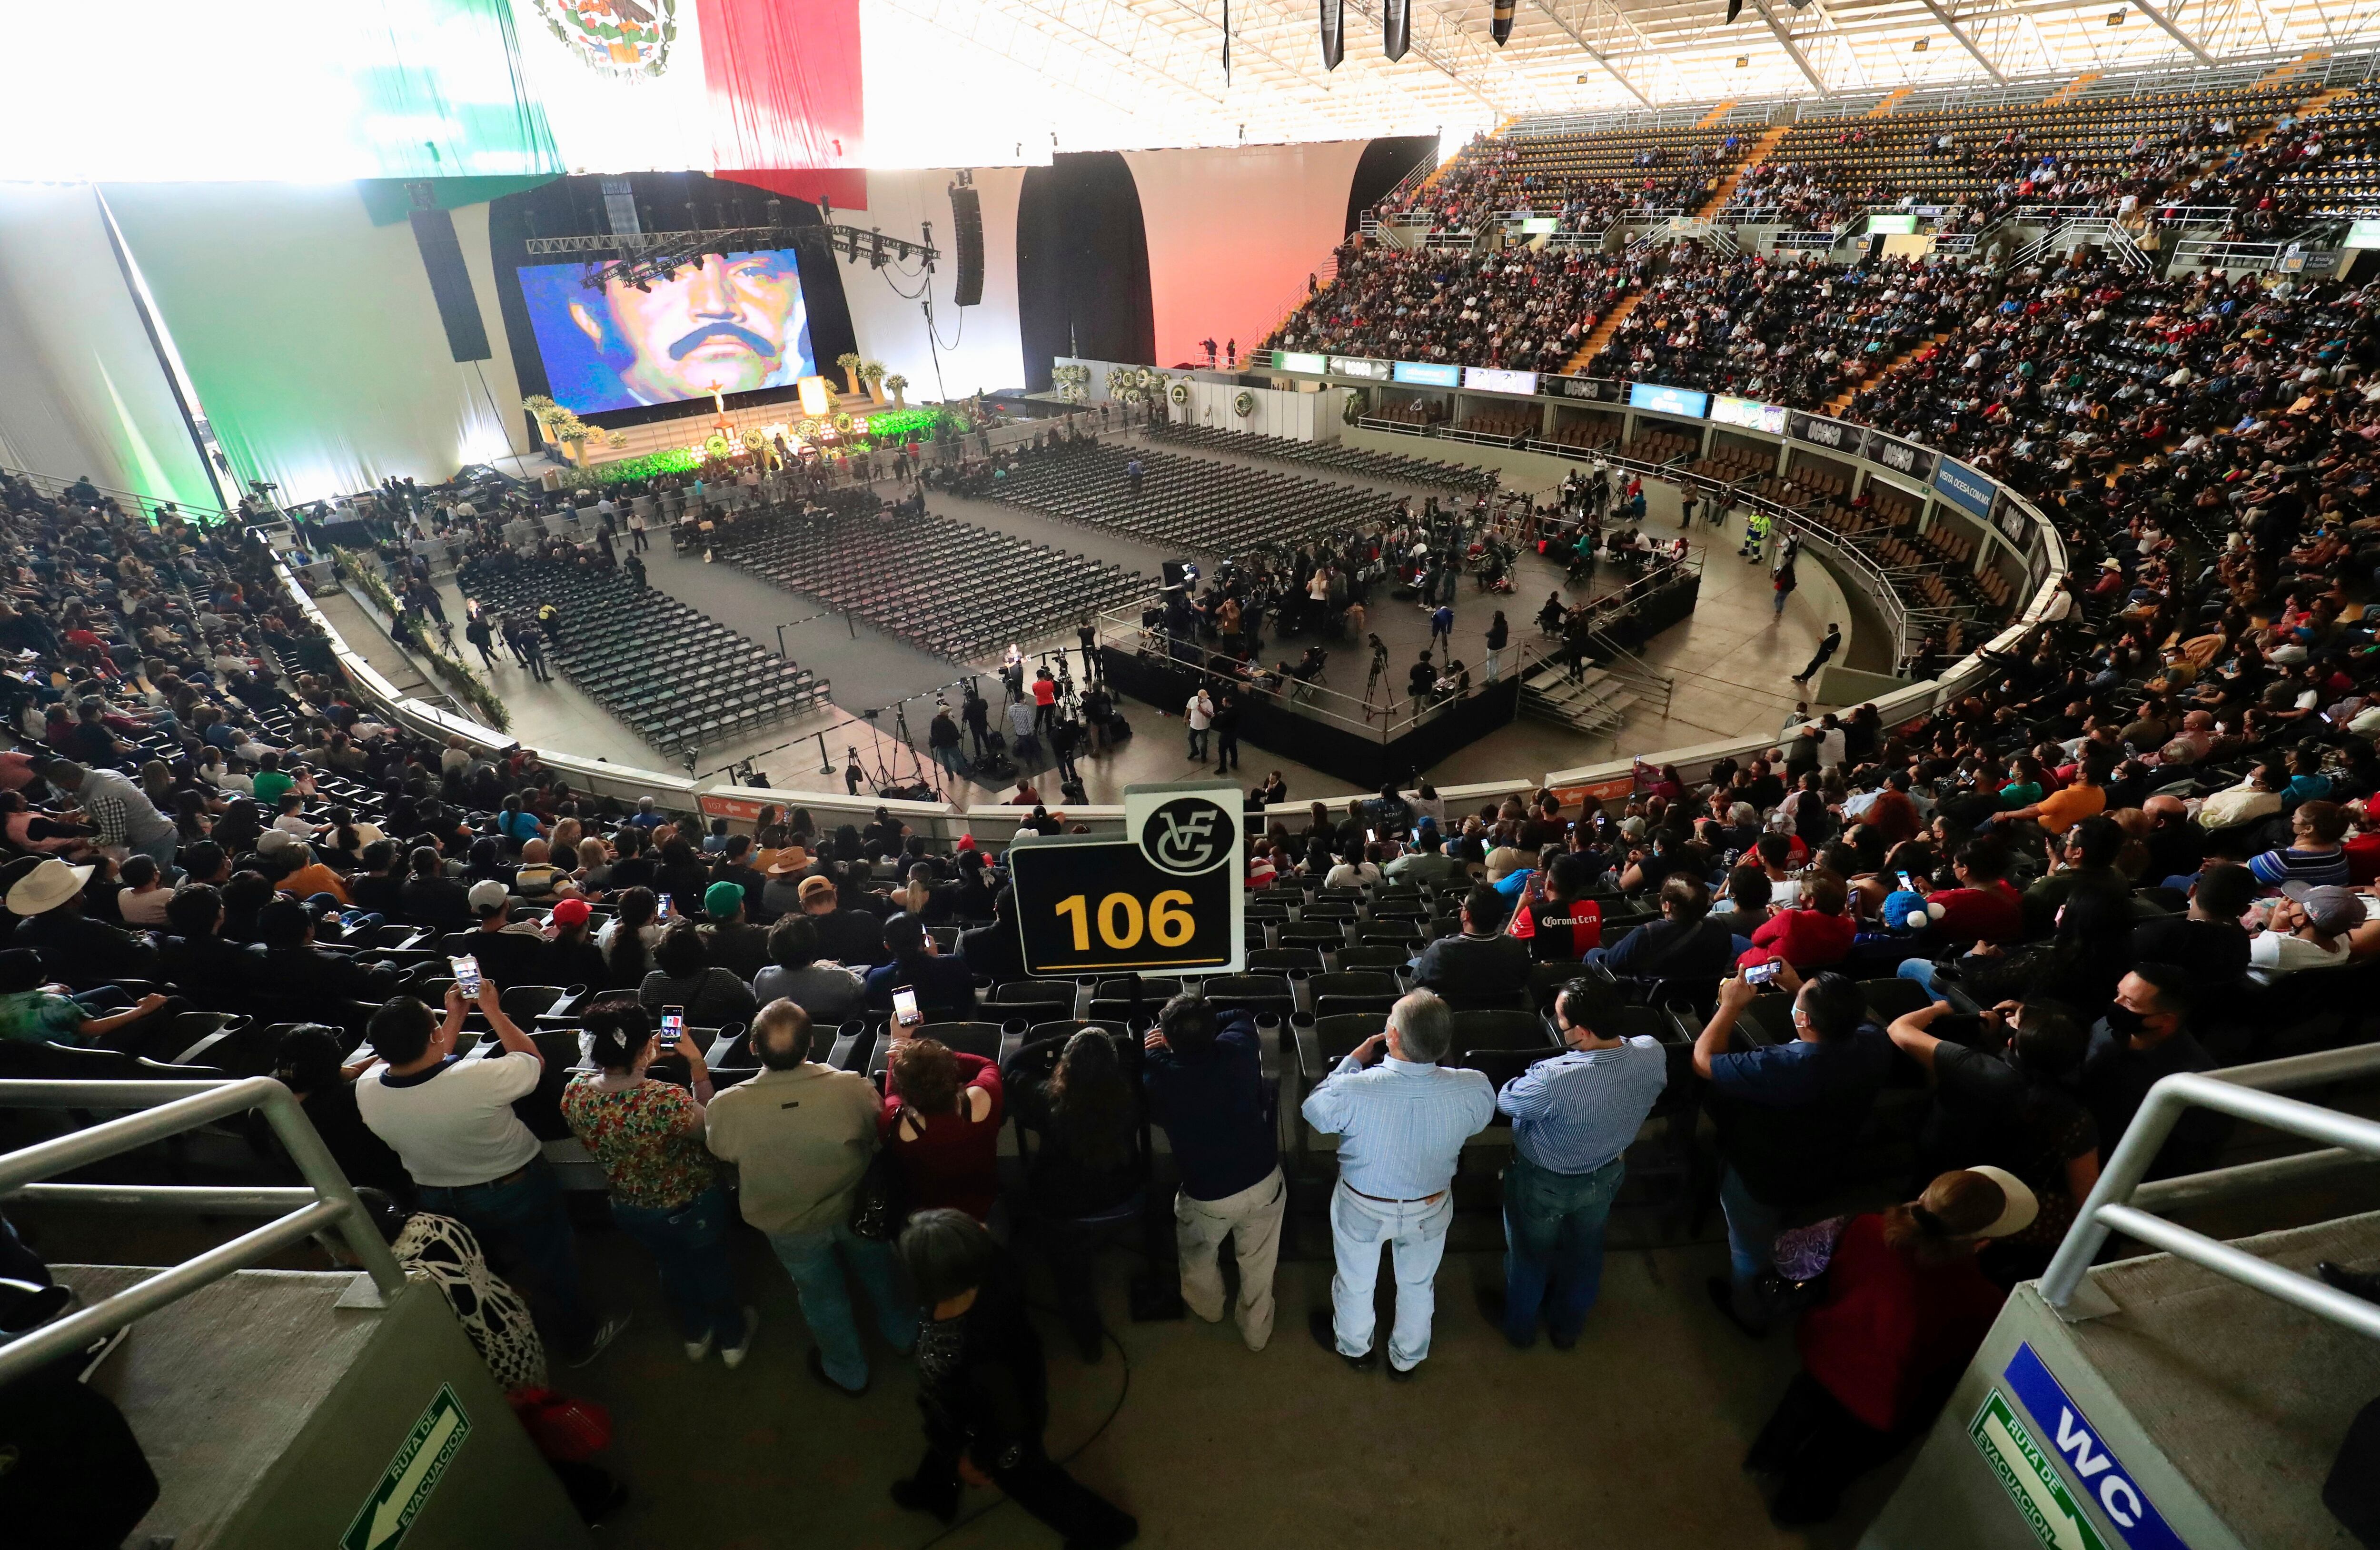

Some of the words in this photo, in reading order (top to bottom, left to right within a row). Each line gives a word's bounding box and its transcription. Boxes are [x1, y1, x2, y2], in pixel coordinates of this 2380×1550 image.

[2109, 15, 2122, 24] 304
[2287, 258, 2302, 268] 103
[1940, 469, 1954, 485] VISITA
[1954, 478, 1990, 506] OCESA.COM.MX
[1055, 889, 1195, 951] 106
[1542, 916, 1578, 928] Corona
[391, 1435, 423, 1481] RUTA
[422, 1410, 439, 1437] DE
[399, 1421, 466, 1528] EVACUACION
[2007, 1419, 2039, 1468] RUTA
[2039, 1465, 2061, 1495] DE
[2056, 1405, 2142, 1527] WC
[1977, 1430, 2057, 1545] EVACUACION
